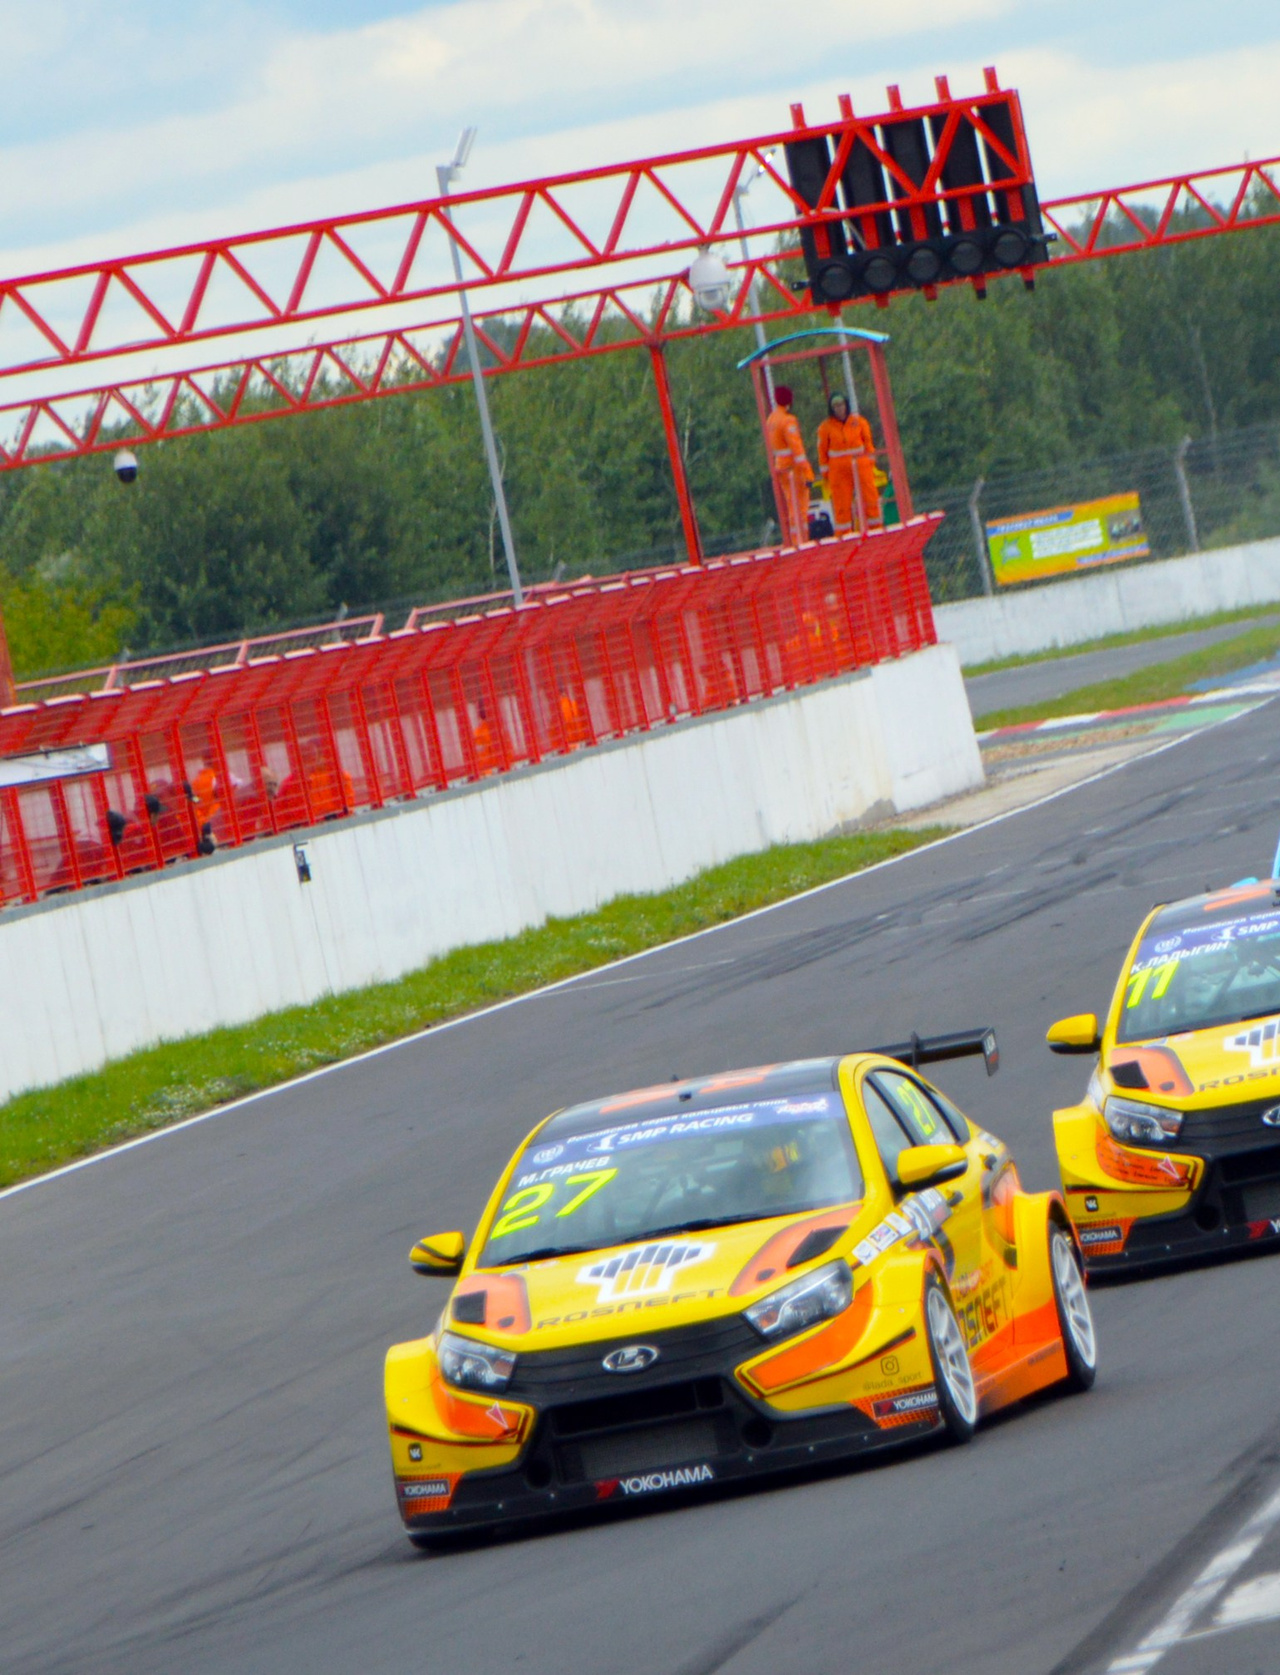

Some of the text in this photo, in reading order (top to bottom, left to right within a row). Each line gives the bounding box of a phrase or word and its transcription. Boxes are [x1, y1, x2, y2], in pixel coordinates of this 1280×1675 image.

[1237, 919, 1279, 936] SMP
[1126, 959, 1180, 1009] 11
[896, 1079, 936, 1136] 27
[618, 1113, 754, 1146] SMP RACING
[490, 1168, 618, 1240] 27
[536, 1287, 724, 1330] ROSNEFT
[404, 1482, 447, 1497] YOKOHAMA
[619, 1464, 714, 1496] YOKOHAMA
